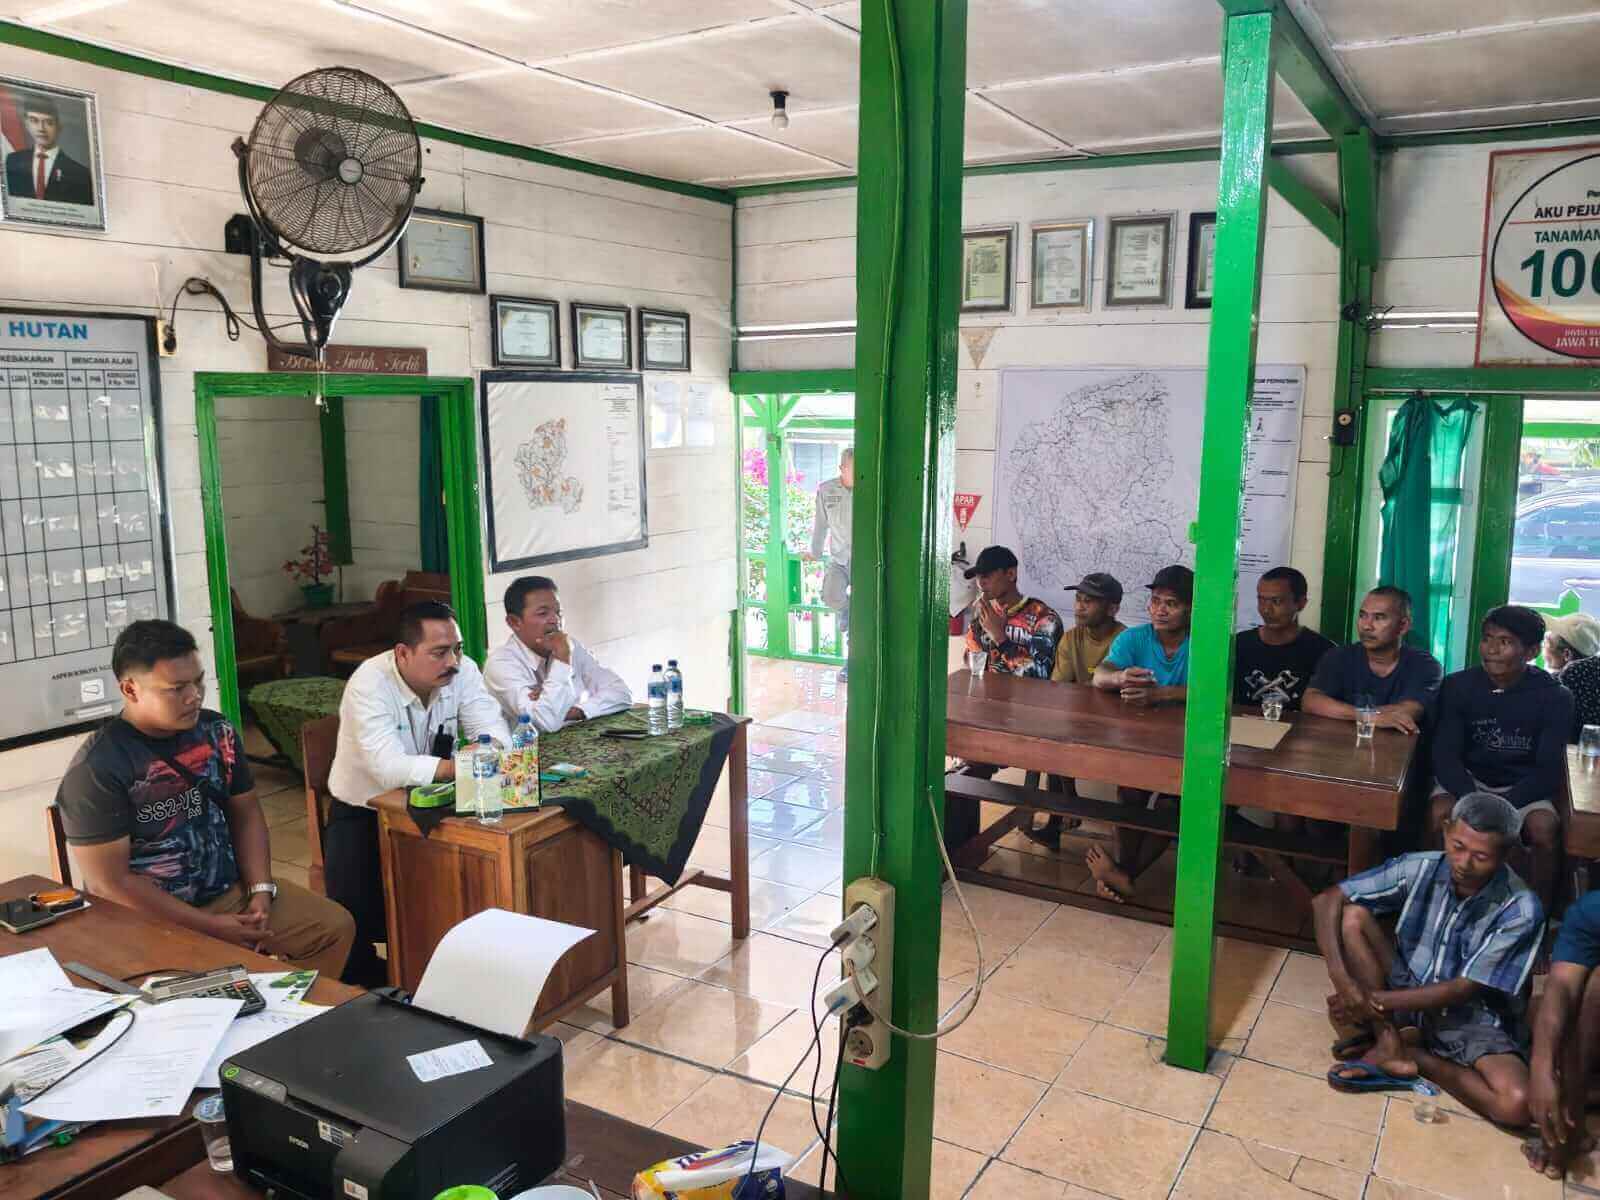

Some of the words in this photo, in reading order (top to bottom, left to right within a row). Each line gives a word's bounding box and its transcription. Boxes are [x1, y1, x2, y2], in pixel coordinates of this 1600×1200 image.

[1534, 205, 1564, 219] AKU
[1520, 248, 1600, 298] 10
[8, 320, 88, 339] HUTAN
[1556, 336, 1586, 348] JAWA
